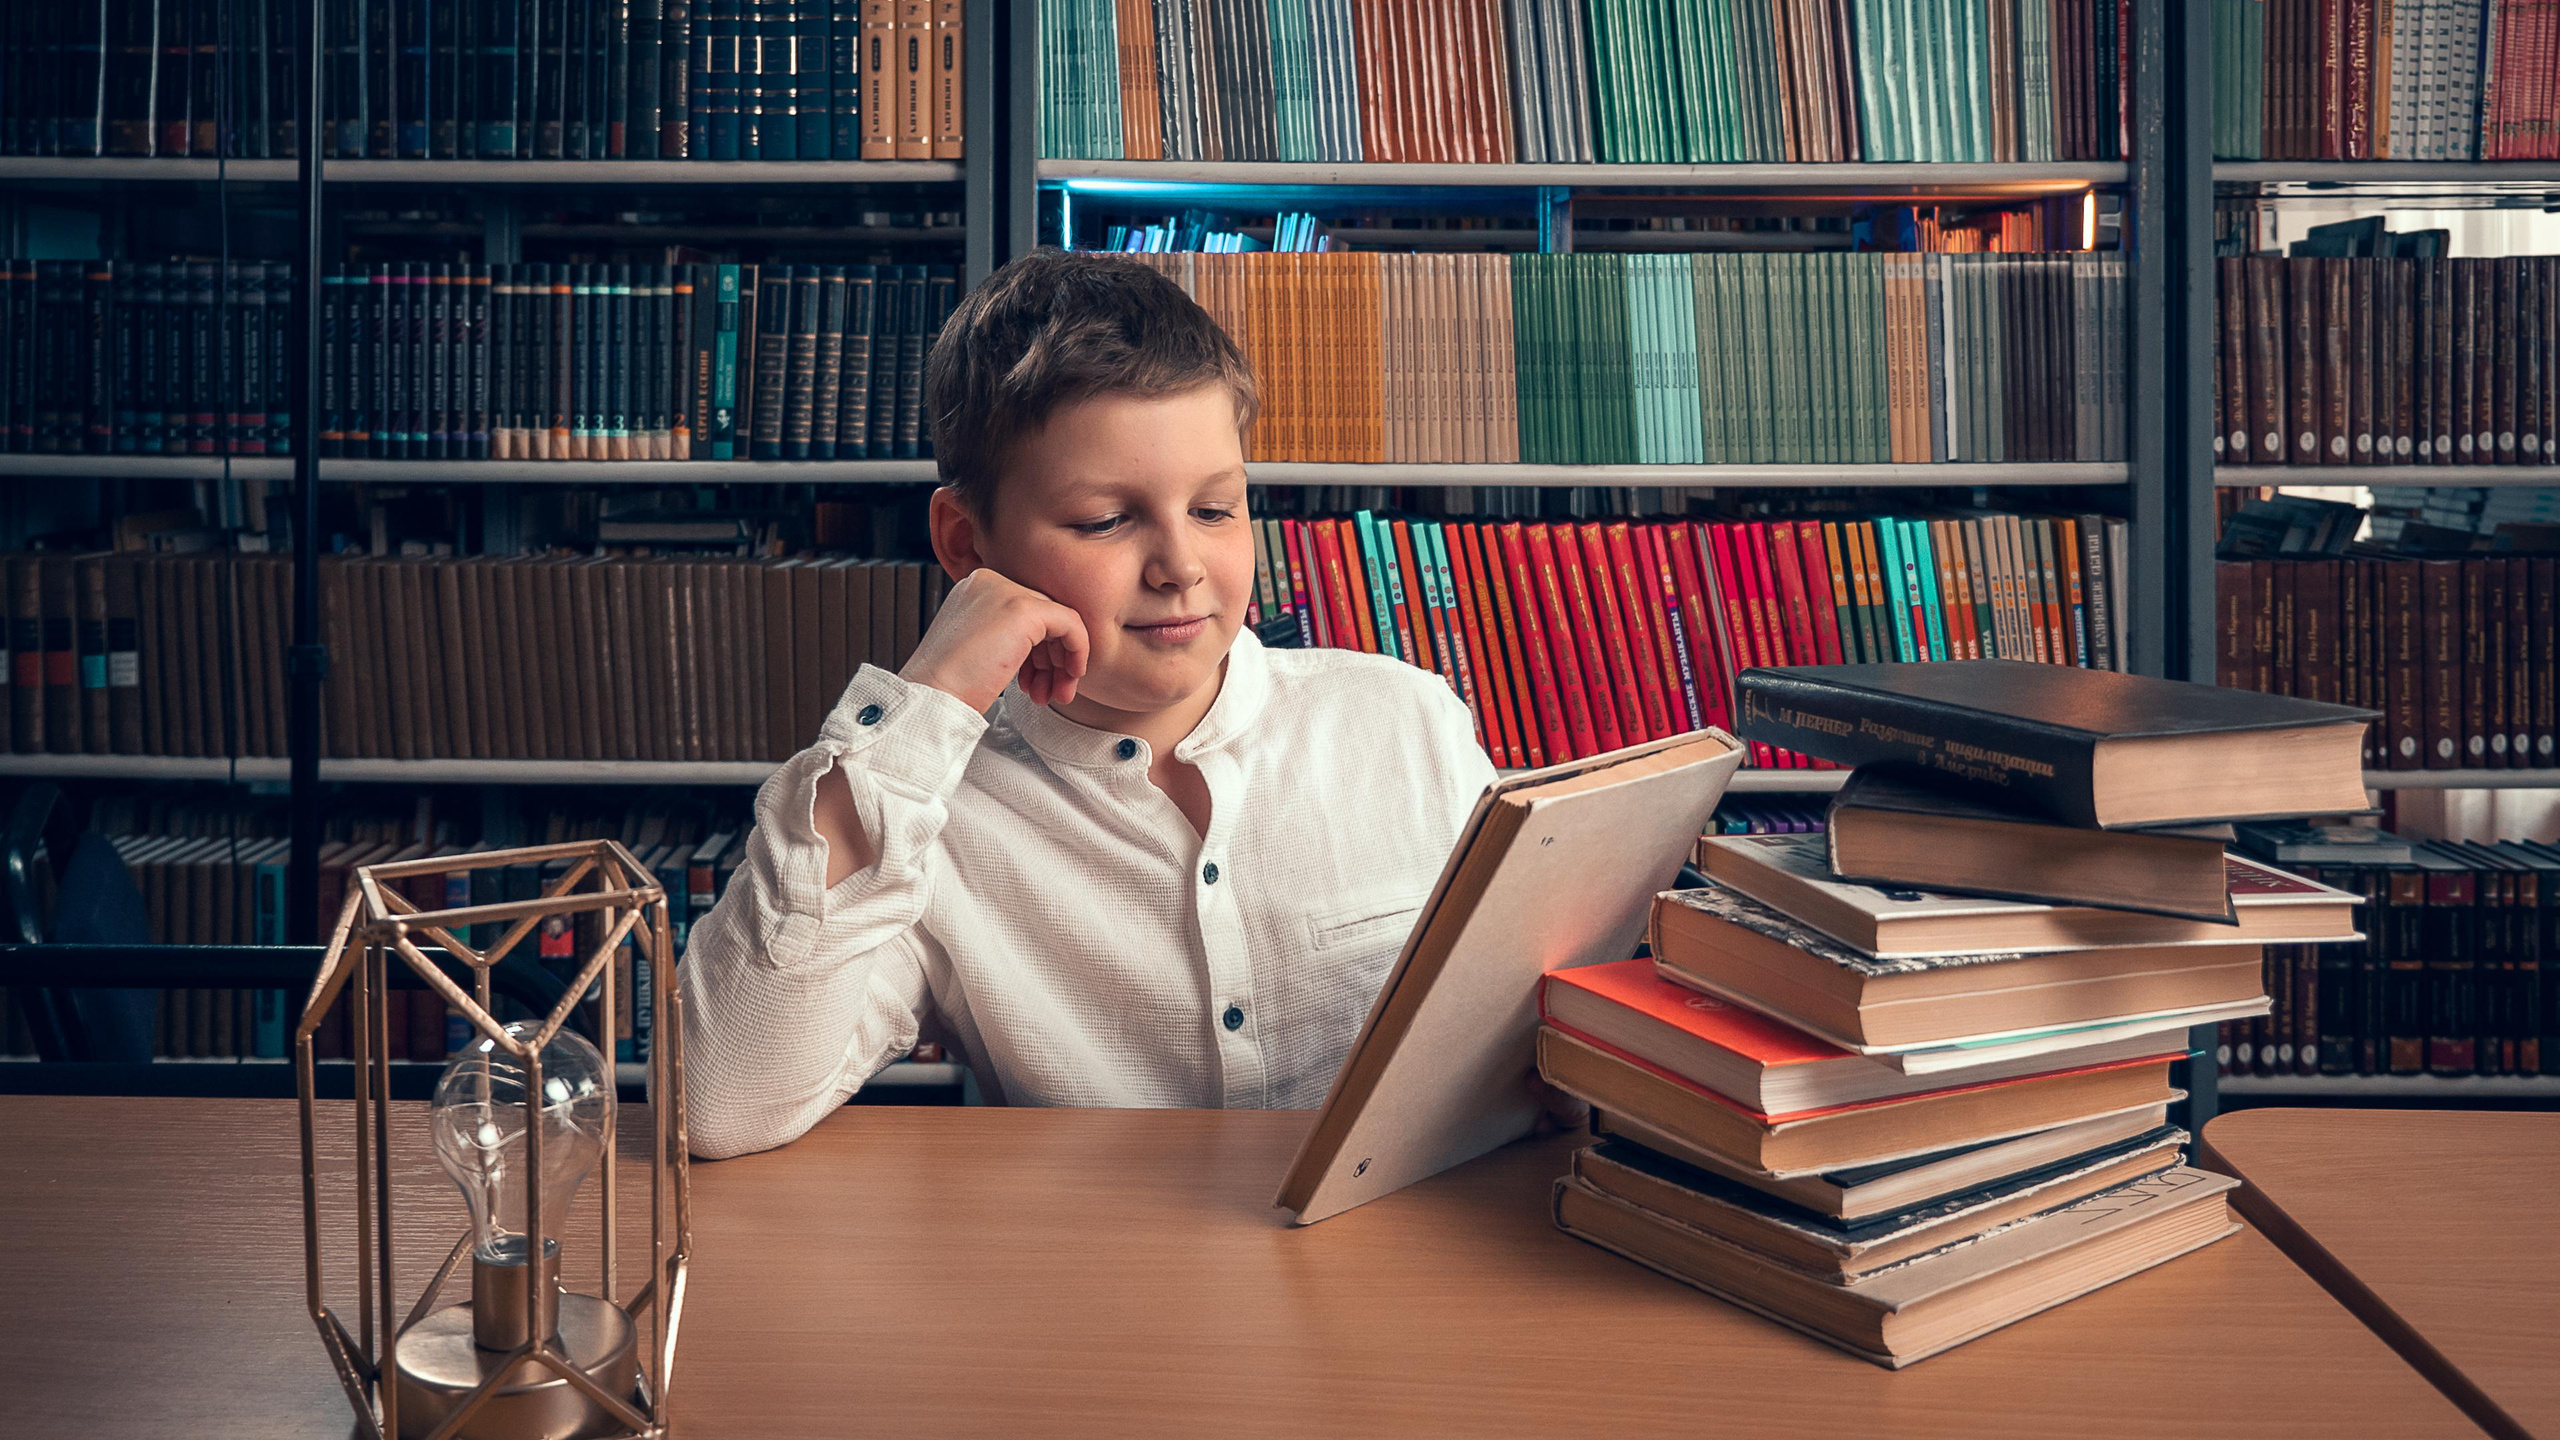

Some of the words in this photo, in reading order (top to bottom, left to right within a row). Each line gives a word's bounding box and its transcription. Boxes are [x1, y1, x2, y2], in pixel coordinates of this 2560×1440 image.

[697, 350, 709, 396] ЕСЕНИН
[574, 414, 586, 430] 3
[592, 414, 604, 430] 3
[613, 414, 625, 430] 3
[696, 399, 708, 442] СЕРГЕЙ
[1299, 608, 1312, 648] КАНТЫ
[1400, 628, 1412, 665] АБОРЕ
[1671, 610, 1691, 680] МУЗЫКАНТЫ
[2073, 607, 2085, 660] ГРЕБЕШОК
[1436, 631, 1450, 671] ЗАБОРЕ
[1453, 631, 1467, 672] ЗАБОРЕ
[1462, 674, 1471, 690] НА
[1859, 717, 1935, 749] Развитие
[1944, 740, 2055, 778] цивилизации
[1934, 752, 2011, 786] Америке
[636, 960, 651, 1028] ПУШКИН
